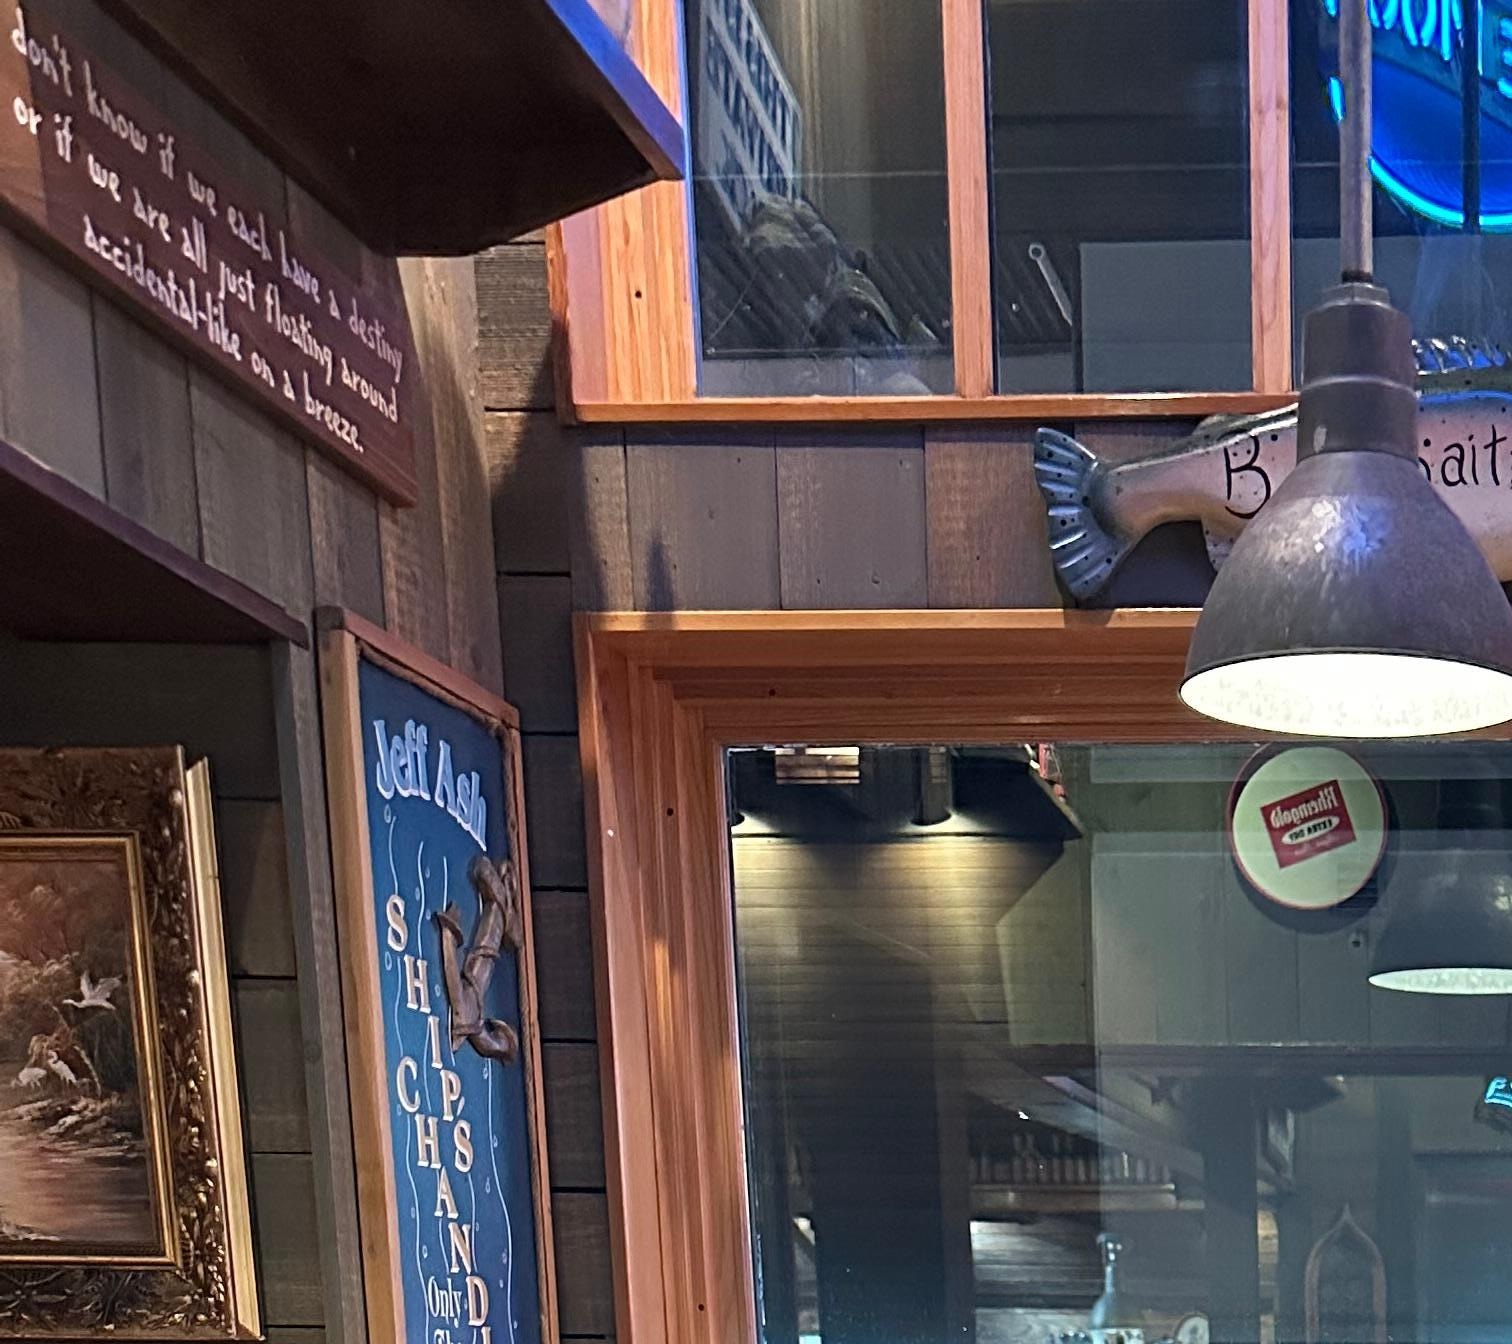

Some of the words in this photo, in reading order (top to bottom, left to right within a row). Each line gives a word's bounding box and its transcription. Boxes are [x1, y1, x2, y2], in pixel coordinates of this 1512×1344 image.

[11, 8, 72, 97] don't
[85, 61, 148, 155] know
[157, 134, 176, 180] if
[187, 168, 218, 216] we
[228, 198, 272, 261] each
[280, 231, 320, 304] have
[328, 290, 341, 321] a
[348, 297, 404, 383] destiny
[13, 96, 43, 136] or
[53, 113, 73, 162] if
[87, 153, 122, 203] we
[132, 187, 172, 245] are
[180, 217, 208, 273] all
[218, 257, 256, 310] just
[265, 284, 333, 386] floating
[340, 354, 398, 425] around
[82, 213, 241, 362] accidental-like
[250, 349, 275, 388] on
[282, 371, 296, 401] a
[303, 371, 365, 454] breeze.
[372, 718, 432, 802] Jeff
[434, 739, 488, 852] Ash
[427, 1275, 462, 1332] Only
